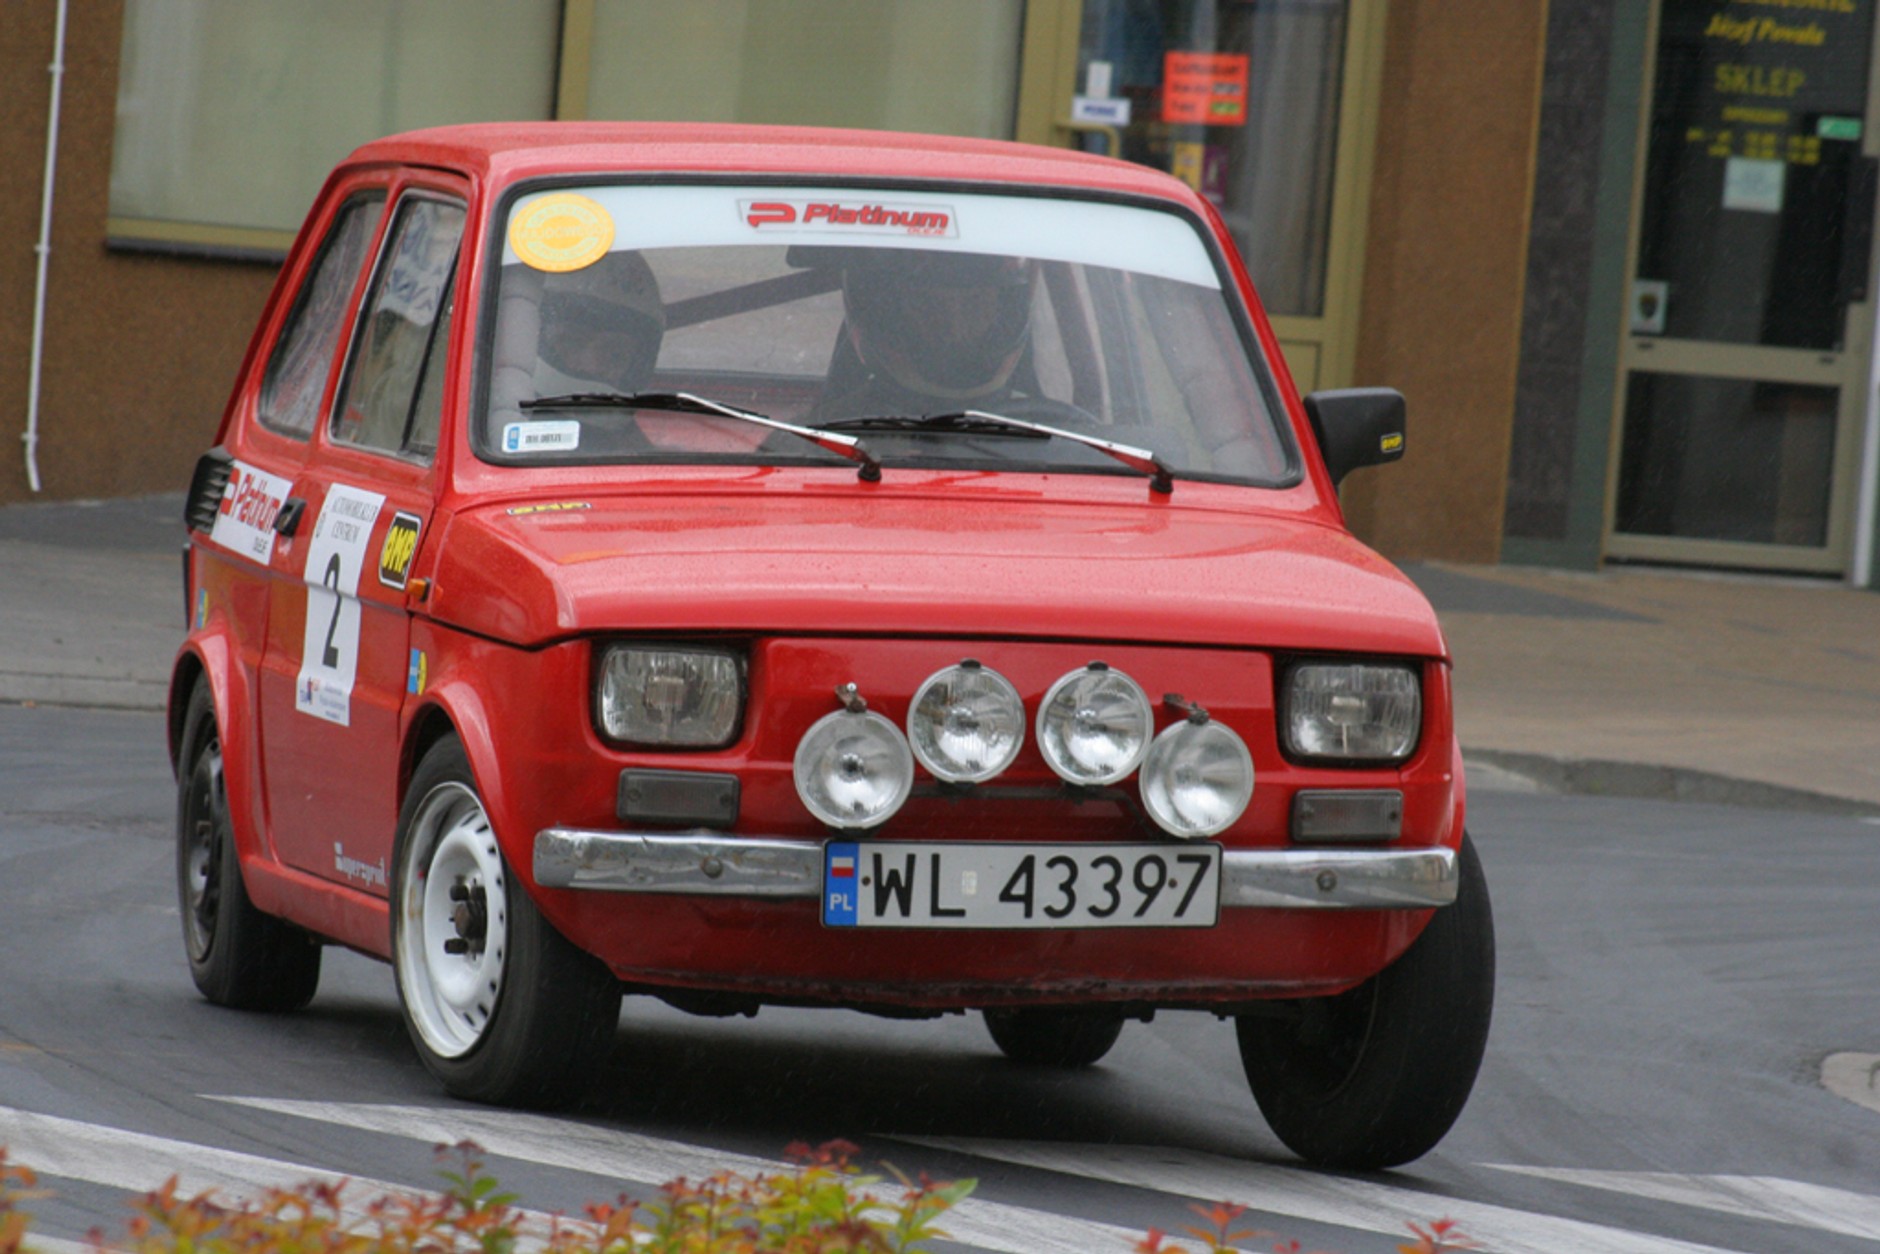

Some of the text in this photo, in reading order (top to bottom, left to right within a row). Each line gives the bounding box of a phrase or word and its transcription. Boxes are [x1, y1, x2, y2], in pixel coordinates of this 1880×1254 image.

[1714, 64, 1806, 97] SKLEP
[802, 203, 949, 229] Platinum
[236, 474, 280, 534] Platinum
[381, 526, 417, 573] OMP
[322, 553, 342, 669] 2
[830, 893, 853, 911] PL
[873, 853, 1212, 919] WL 43397
